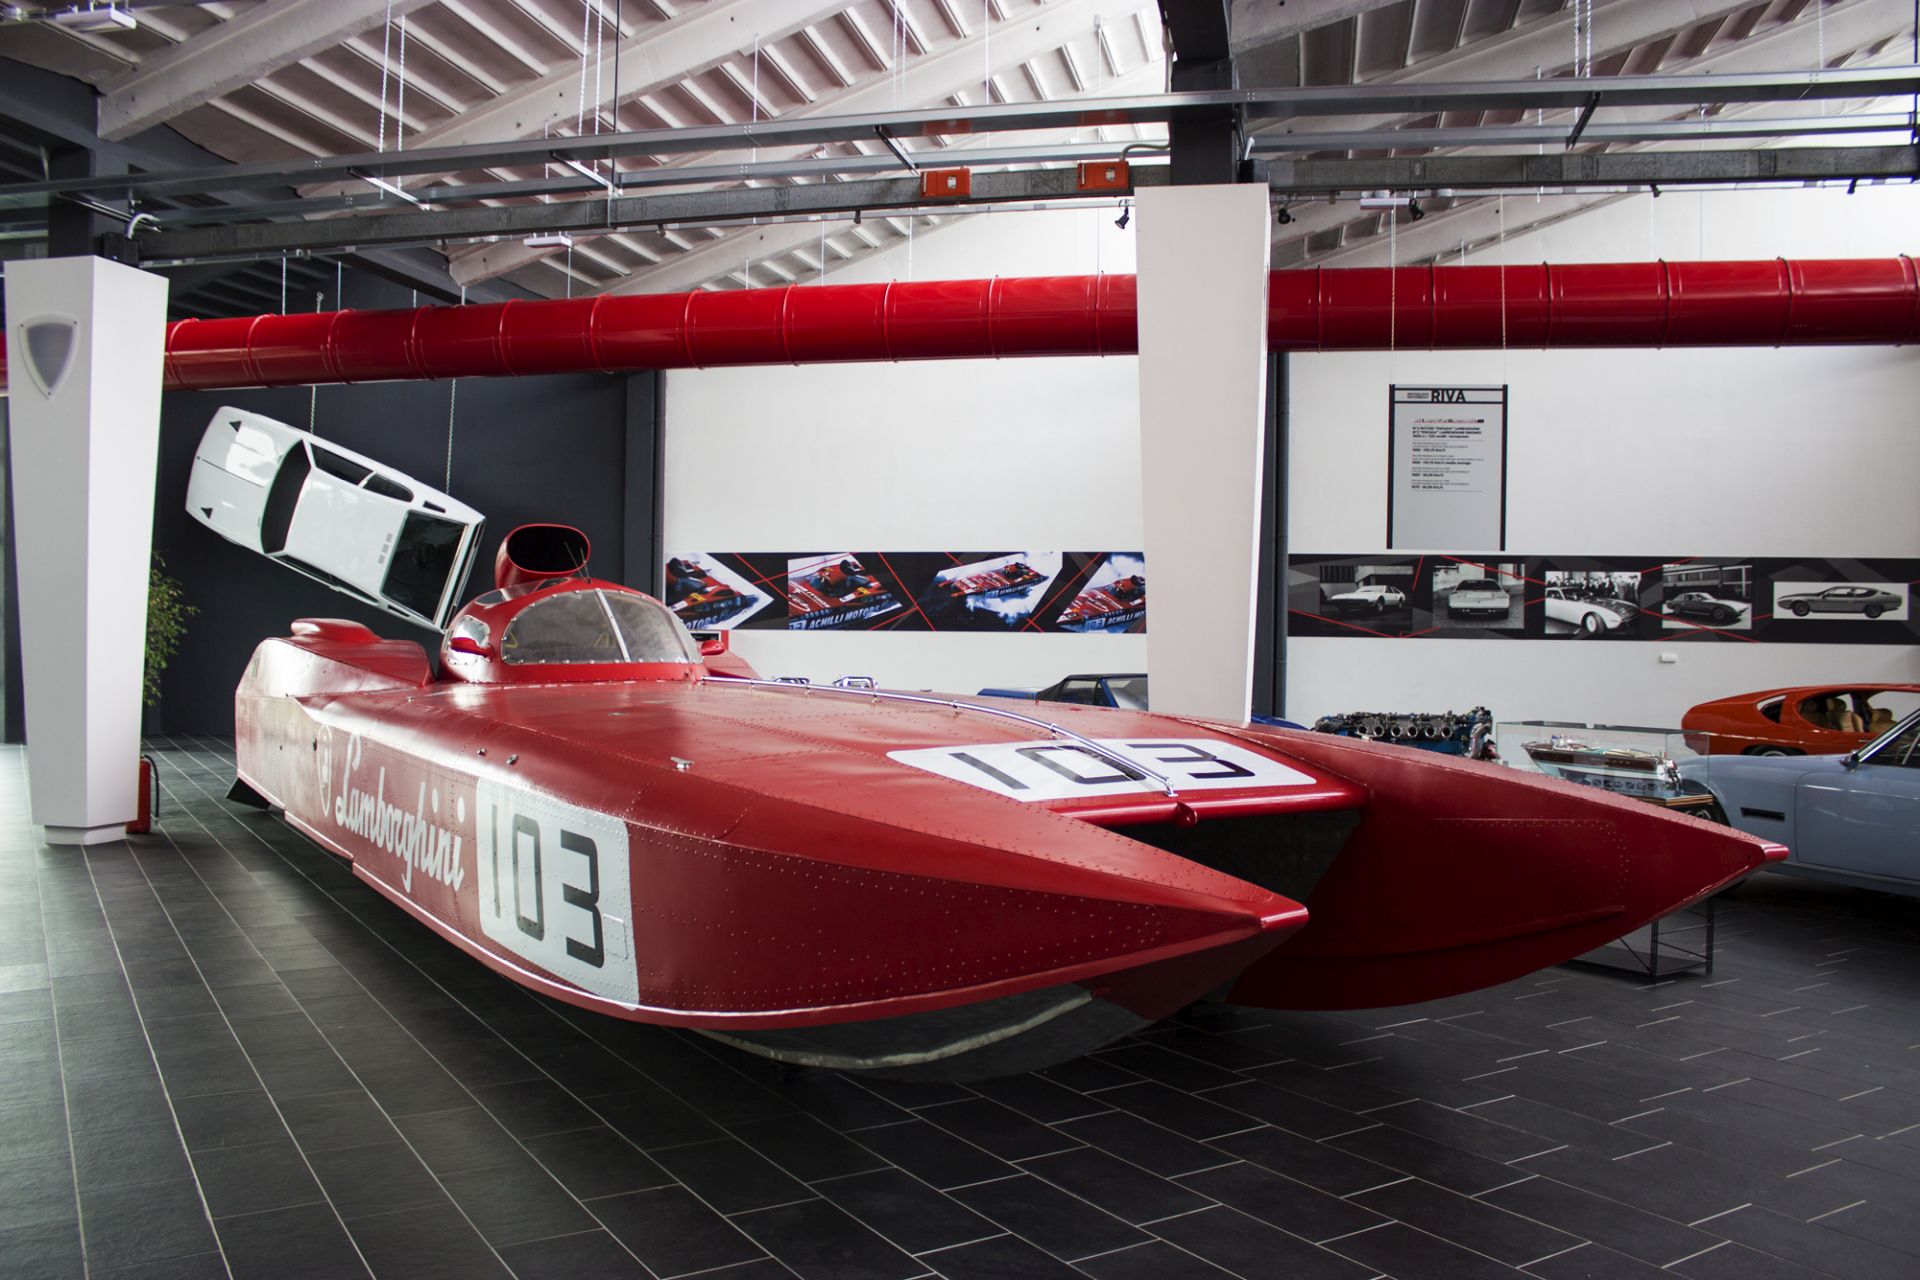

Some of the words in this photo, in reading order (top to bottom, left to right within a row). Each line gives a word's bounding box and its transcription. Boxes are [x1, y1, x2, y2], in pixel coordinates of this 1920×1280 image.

[1431, 389, 1466, 402] RIVA
[682, 615, 718, 630] OTORS
[808, 614, 845, 629] ACHILLI
[948, 743, 1256, 790] 103
[334, 727, 466, 893] Lamborghini
[491, 804, 605, 969] 103
